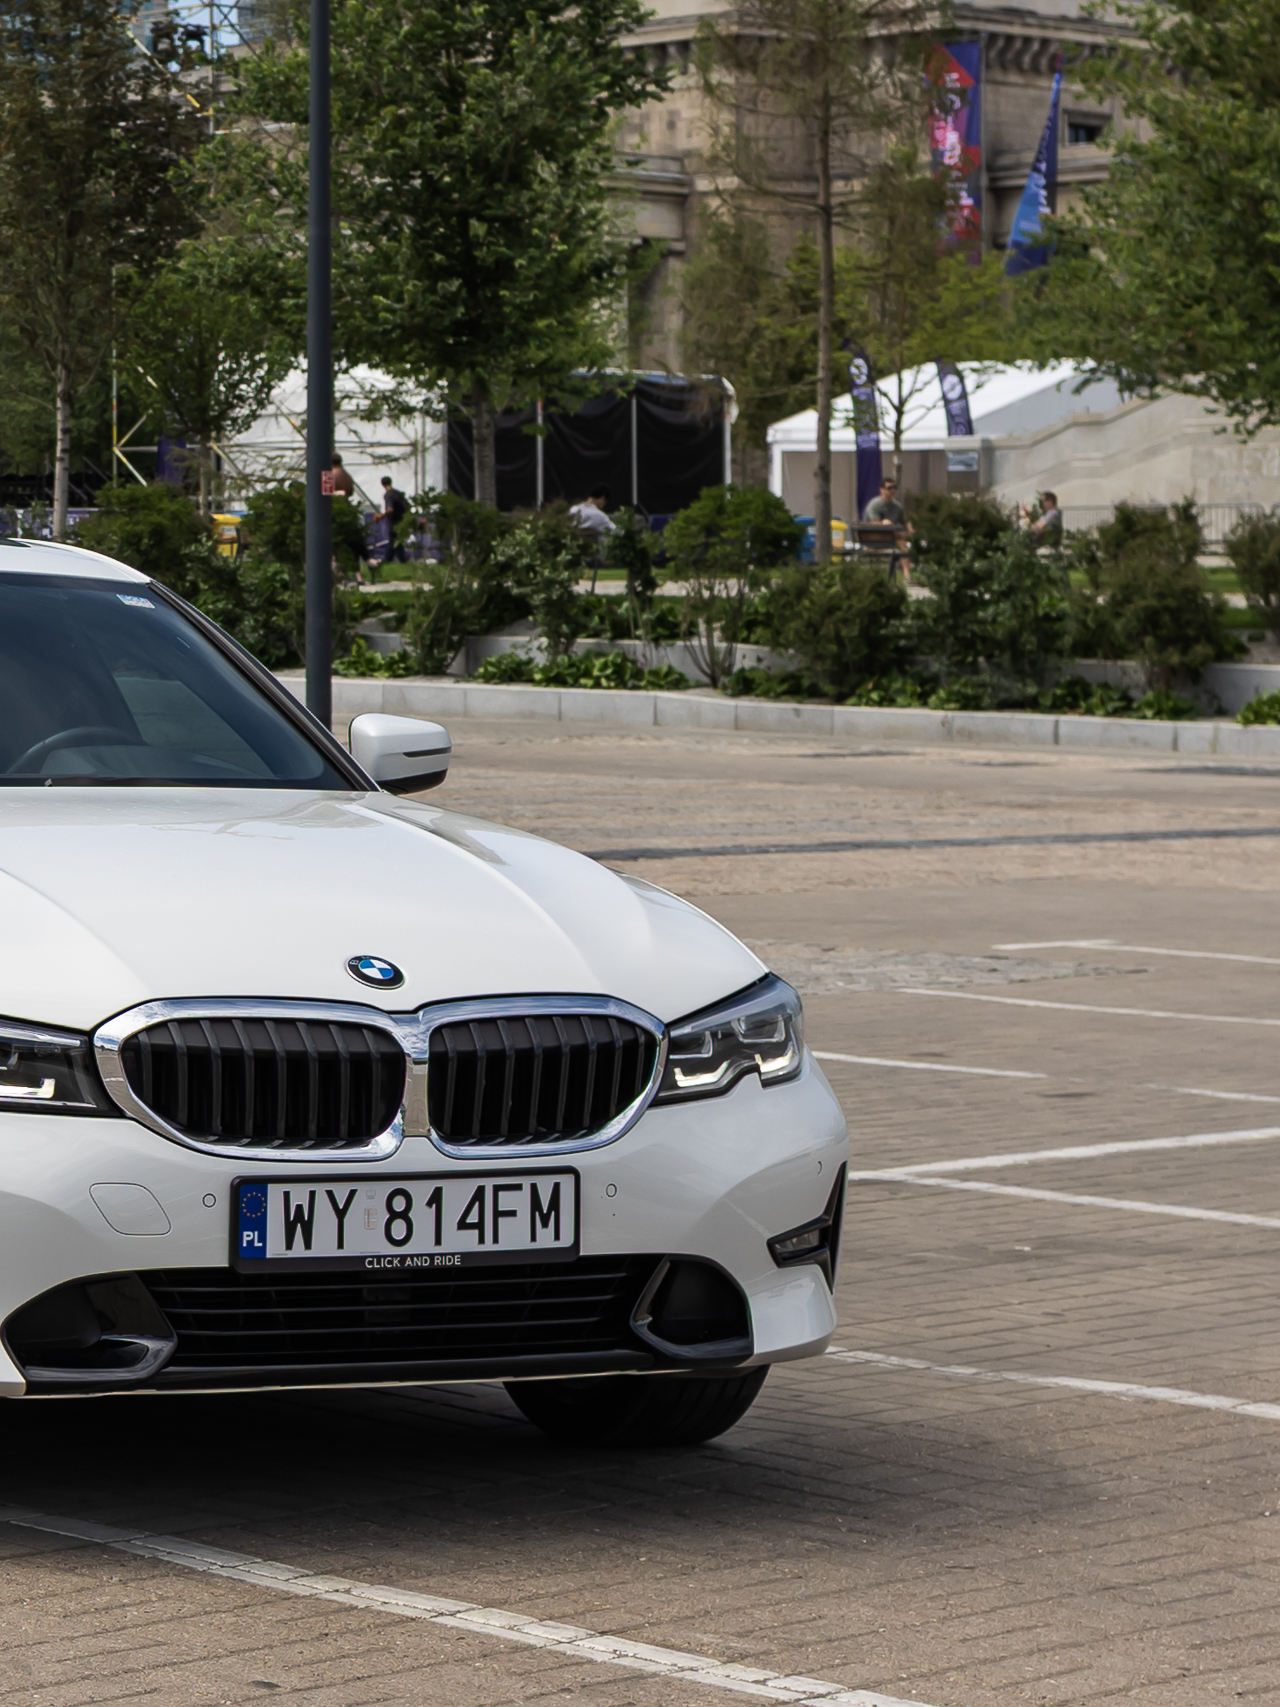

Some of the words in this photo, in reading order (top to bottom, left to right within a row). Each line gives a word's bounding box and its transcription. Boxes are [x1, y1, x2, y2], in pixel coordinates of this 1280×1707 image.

[282, 1188, 359, 1251] WY
[383, 1181, 561, 1248] 814FM
[242, 1230, 263, 1247] PL
[365, 1256, 401, 1269] CLICK
[405, 1255, 431, 1268] AND
[434, 1254, 462, 1267] RIDE
